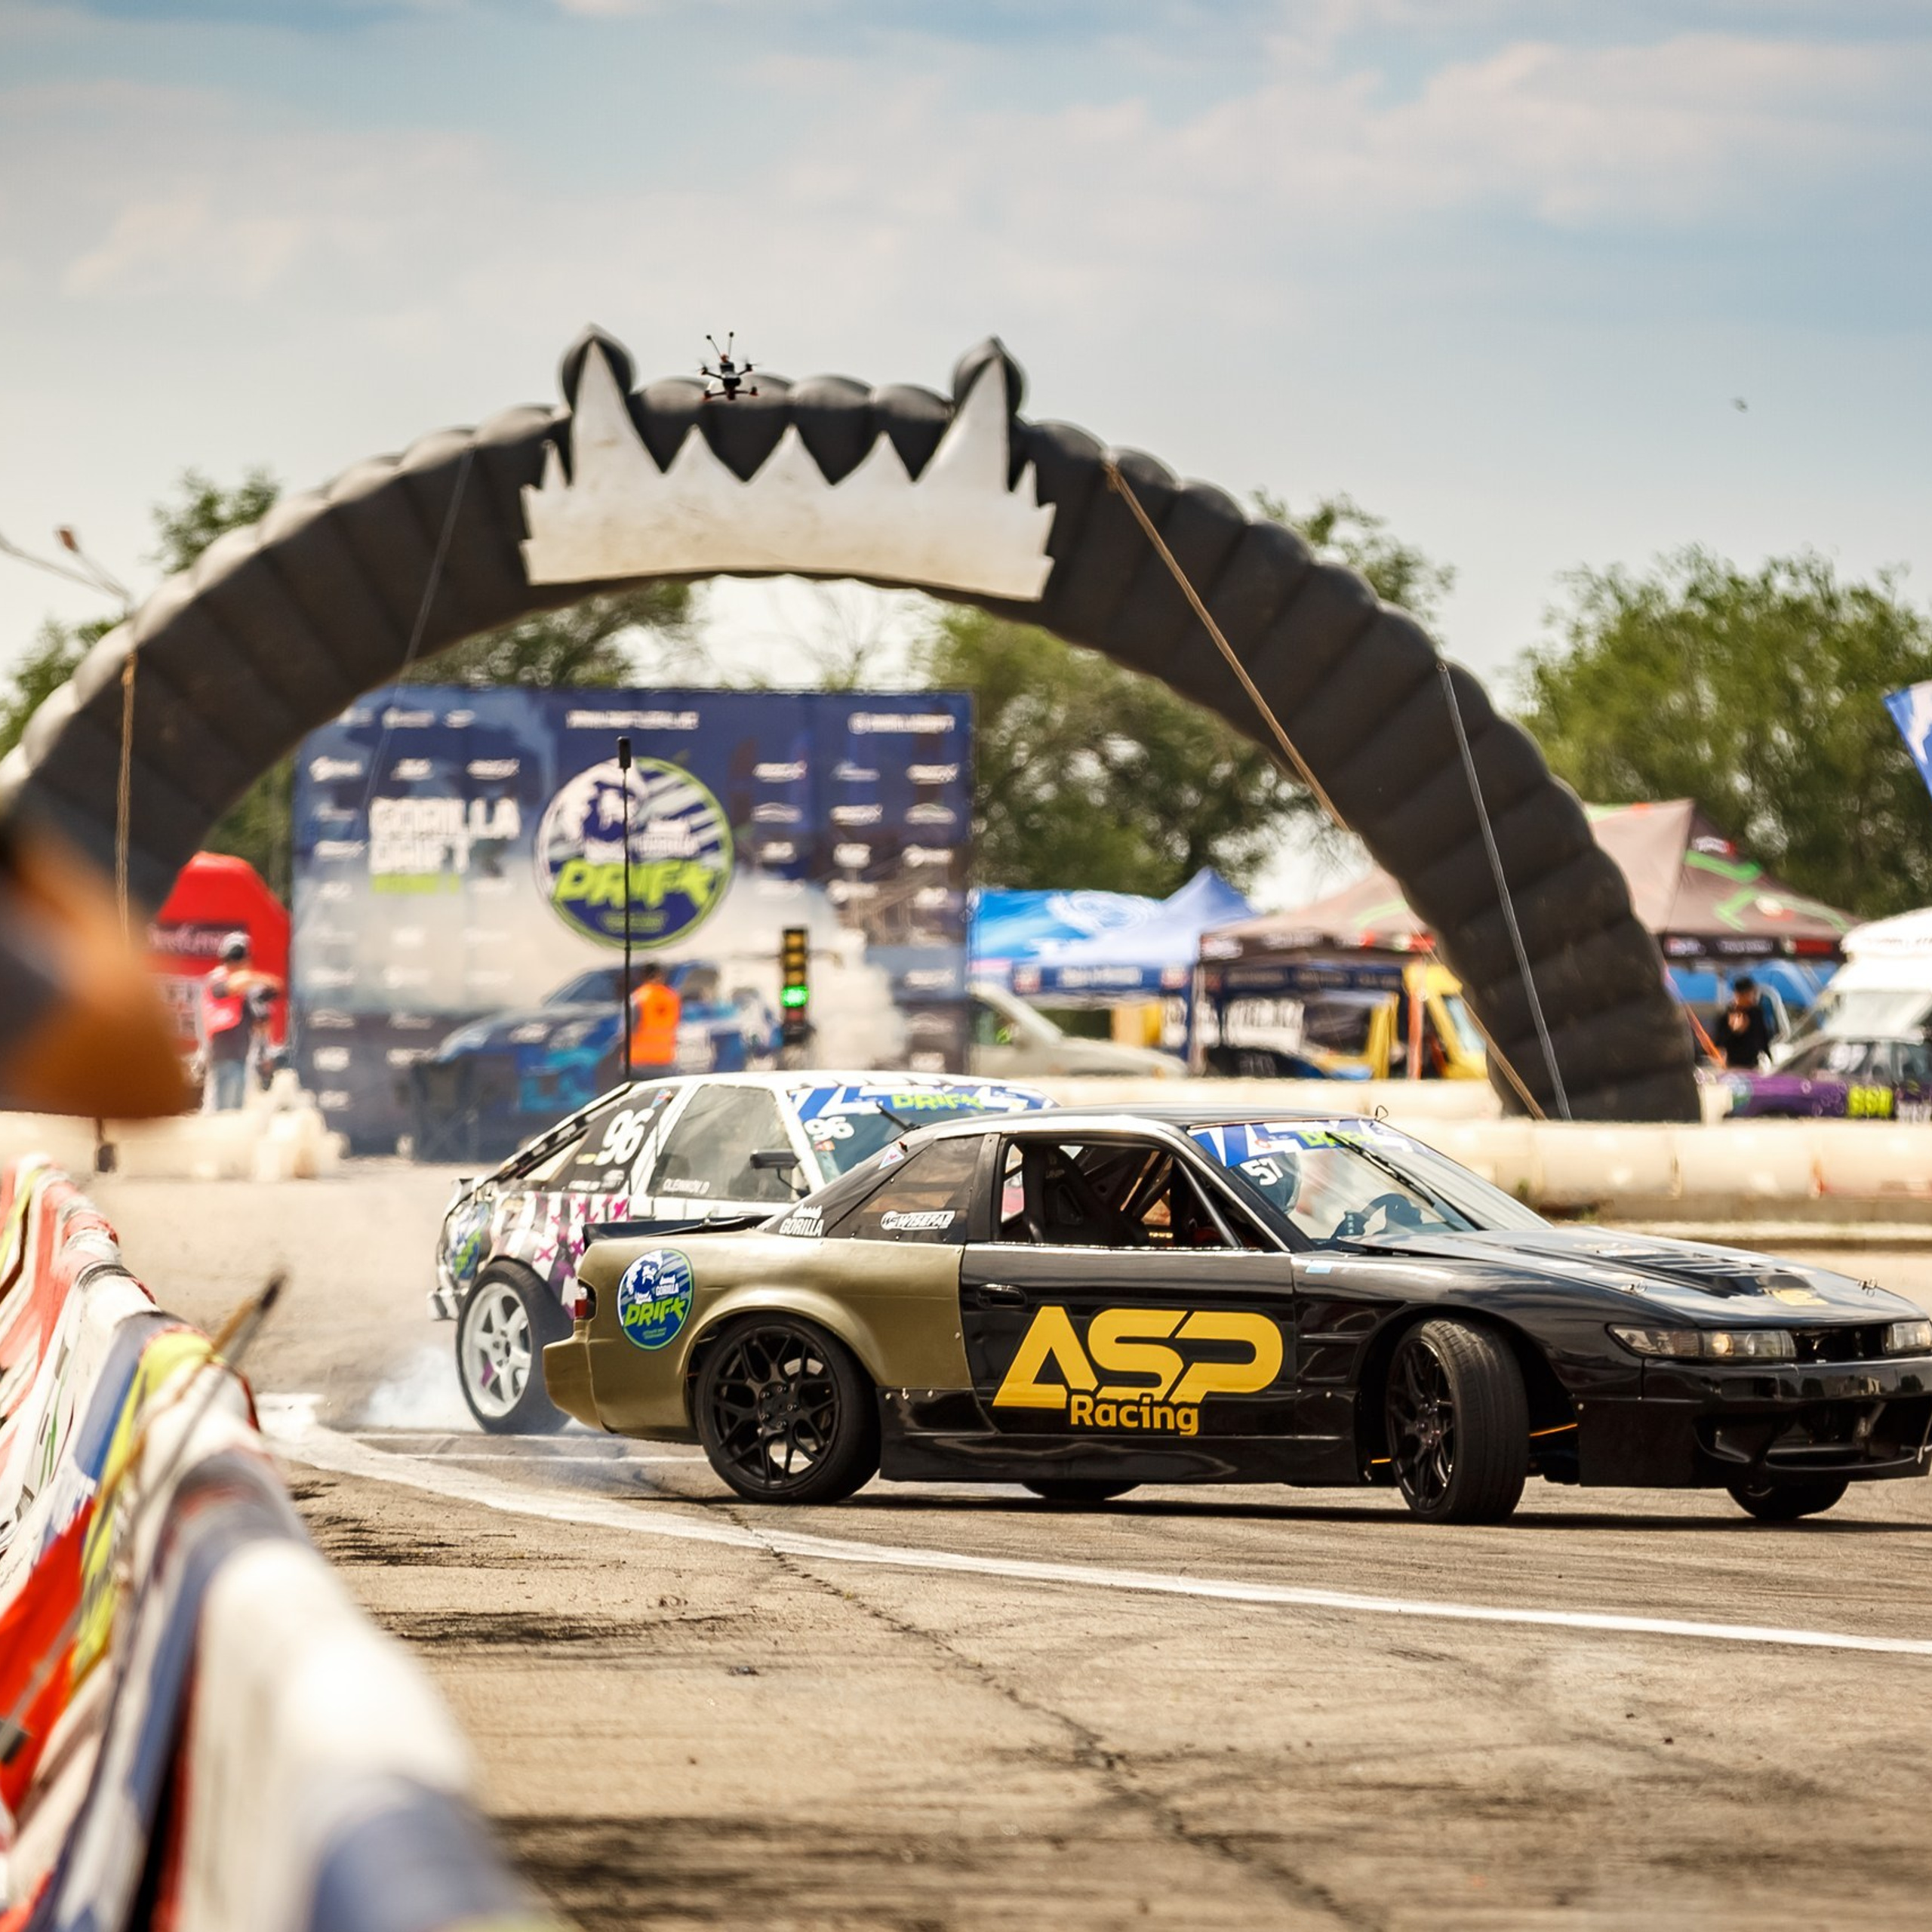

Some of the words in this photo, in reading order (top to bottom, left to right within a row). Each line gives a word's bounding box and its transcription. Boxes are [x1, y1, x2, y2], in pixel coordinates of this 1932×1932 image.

[594, 1108, 655, 1166] 96
[803, 1115, 855, 1141] 96
[1240, 1157, 1283, 1186] 57
[779, 1217, 825, 1237] GORILLA
[992, 1305, 1283, 1409] ASP
[1070, 1394, 1199, 1436] Racing
